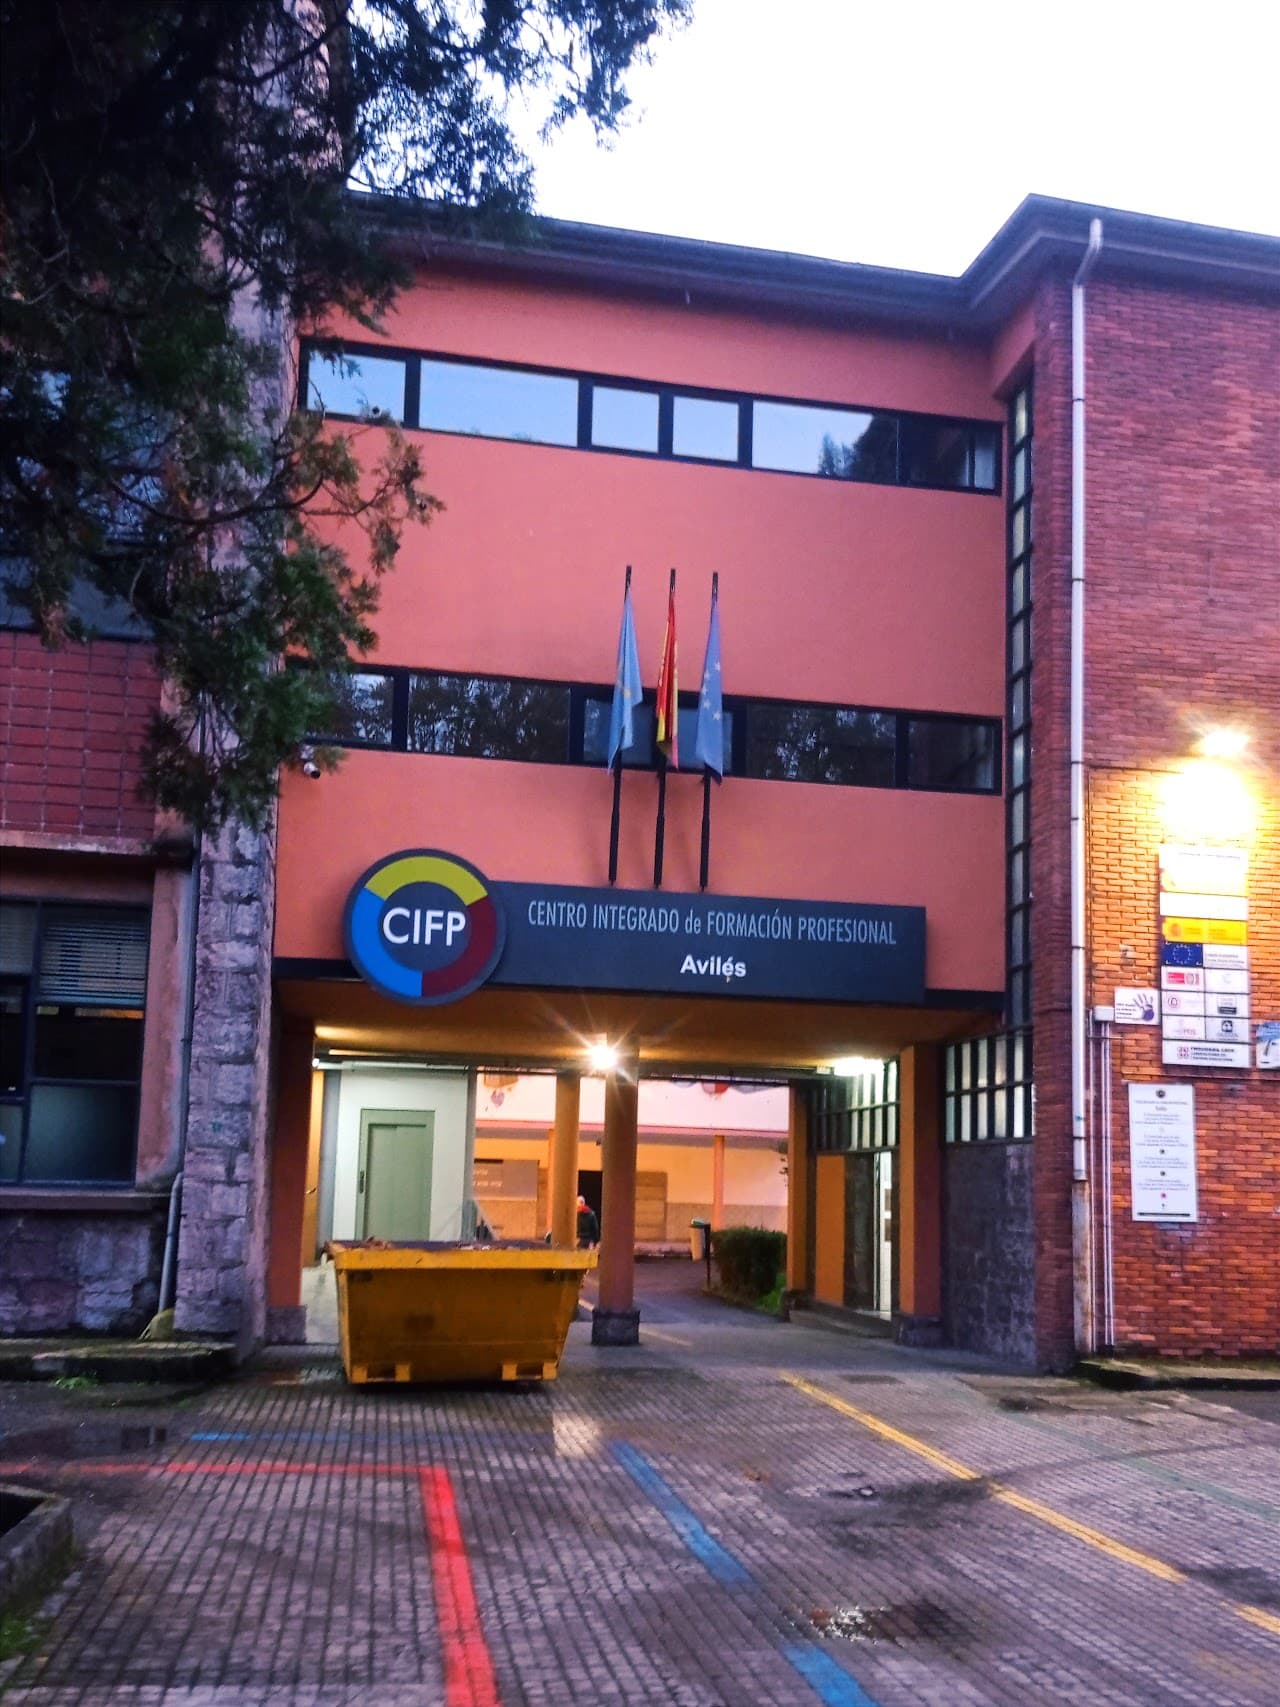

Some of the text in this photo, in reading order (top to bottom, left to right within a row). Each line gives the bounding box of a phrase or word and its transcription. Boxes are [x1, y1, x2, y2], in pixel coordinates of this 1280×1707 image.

[382, 906, 466, 946] CIFP
[527, 900, 897, 945] CENTRO INTEGRADO de FORMACIÓN PROFESIONAL
[679, 954, 747, 978] Avilés
